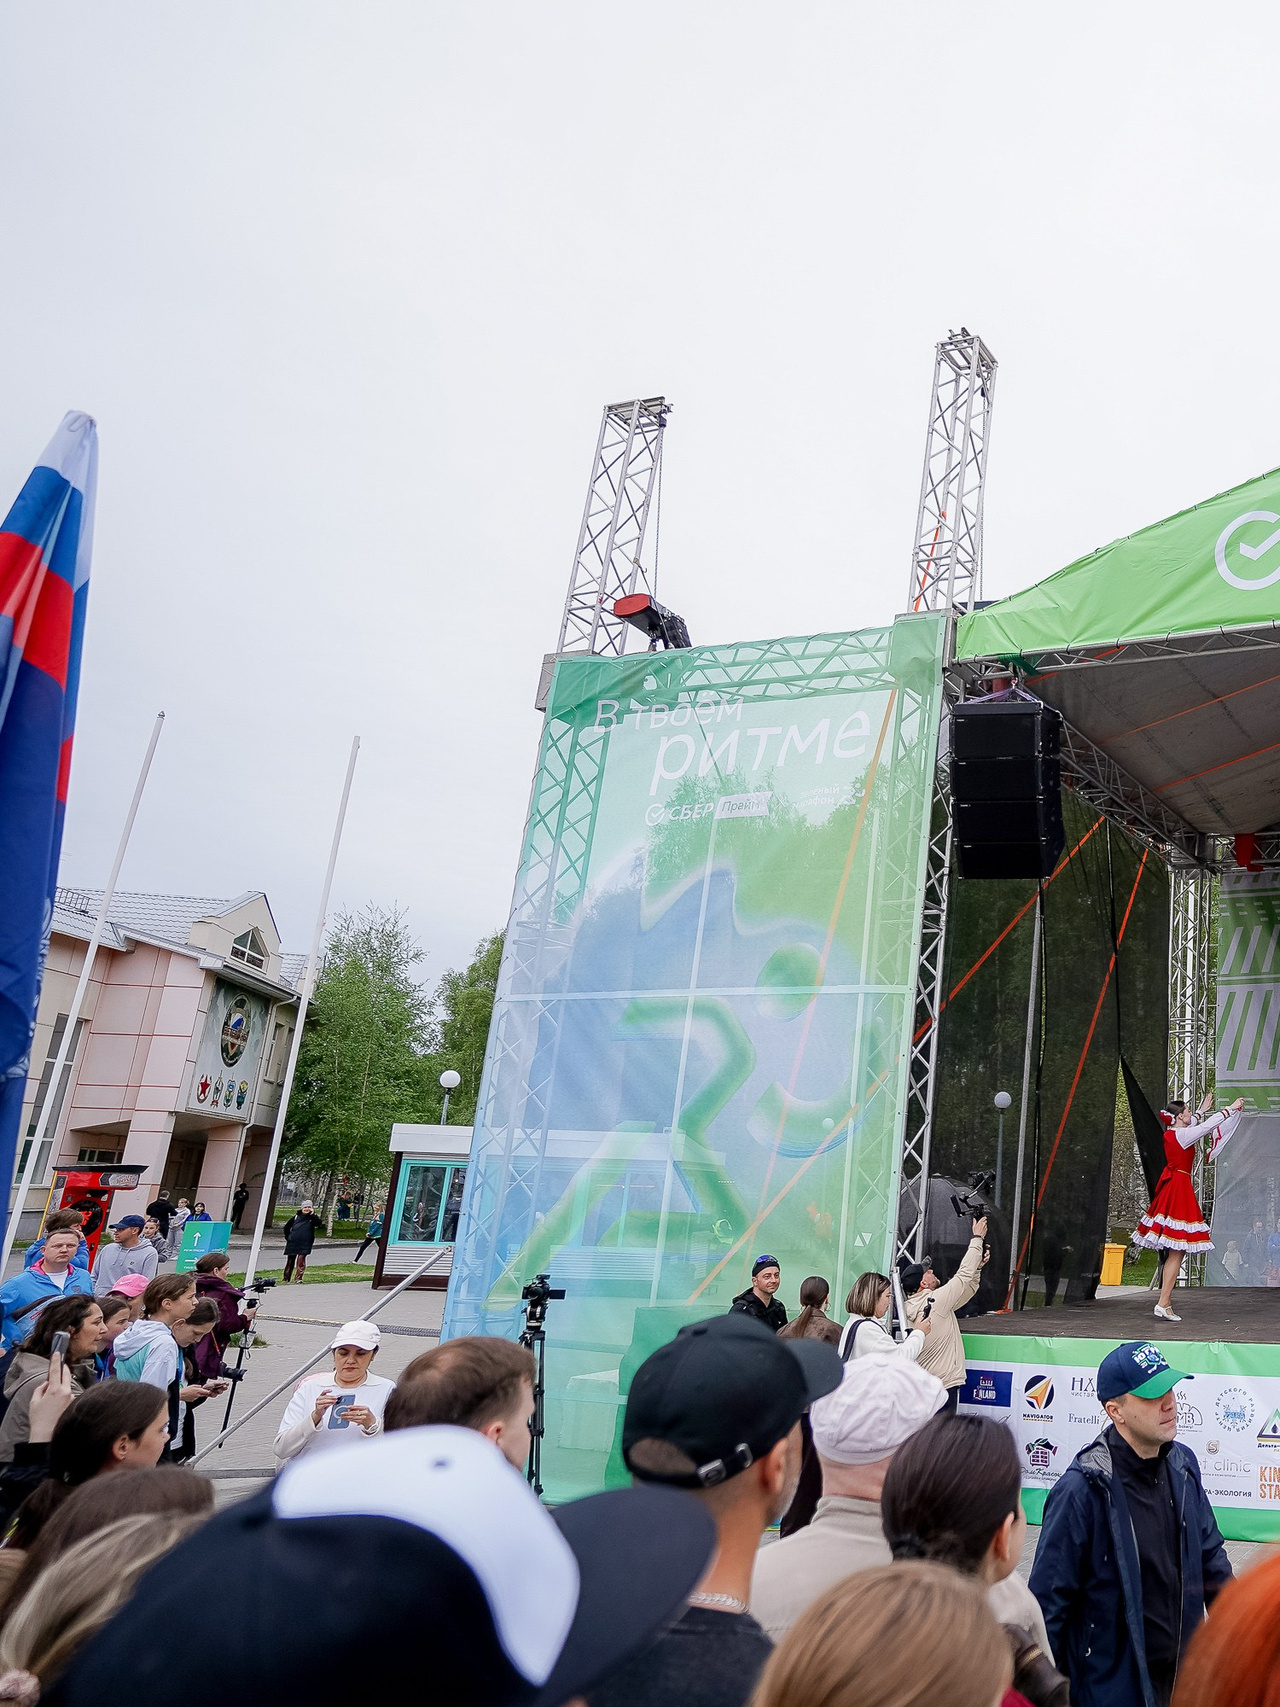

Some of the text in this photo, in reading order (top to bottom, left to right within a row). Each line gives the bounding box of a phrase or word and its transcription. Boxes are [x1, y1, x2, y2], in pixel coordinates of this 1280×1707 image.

[594, 692, 744, 733] В твоём
[649, 709, 870, 796] ритме
[668, 802, 714, 821] СБЕР
[1068, 1413, 1100, 1425] Fratelli
[1213, 1459, 1251, 1473] clinic
[1204, 1489, 1252, 1498] РА-ЭКОЛОГИЯ
